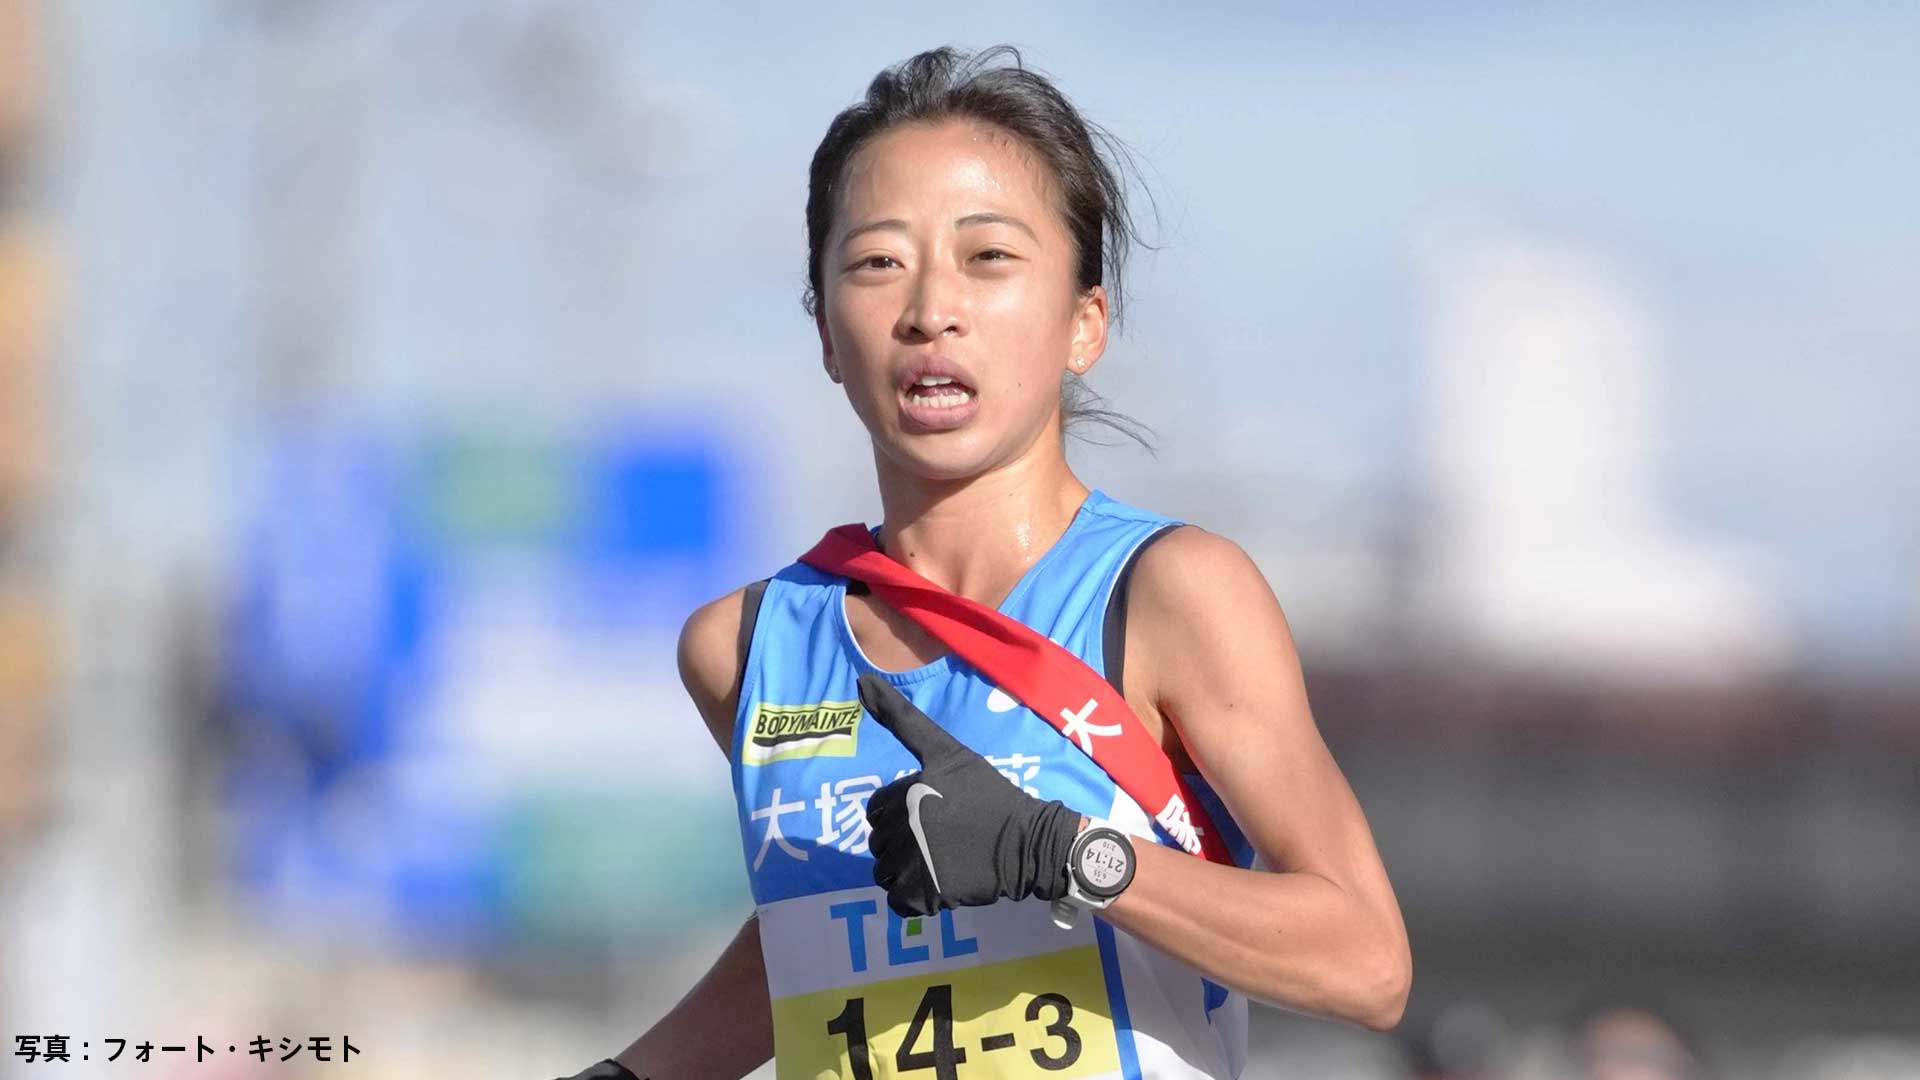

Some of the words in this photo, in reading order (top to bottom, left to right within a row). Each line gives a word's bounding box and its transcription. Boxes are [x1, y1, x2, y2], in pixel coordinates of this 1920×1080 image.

[1086, 848, 1124, 873] 21:14
[829, 899, 979, 973] TEL
[826, 984, 1083, 1080] 14-3
